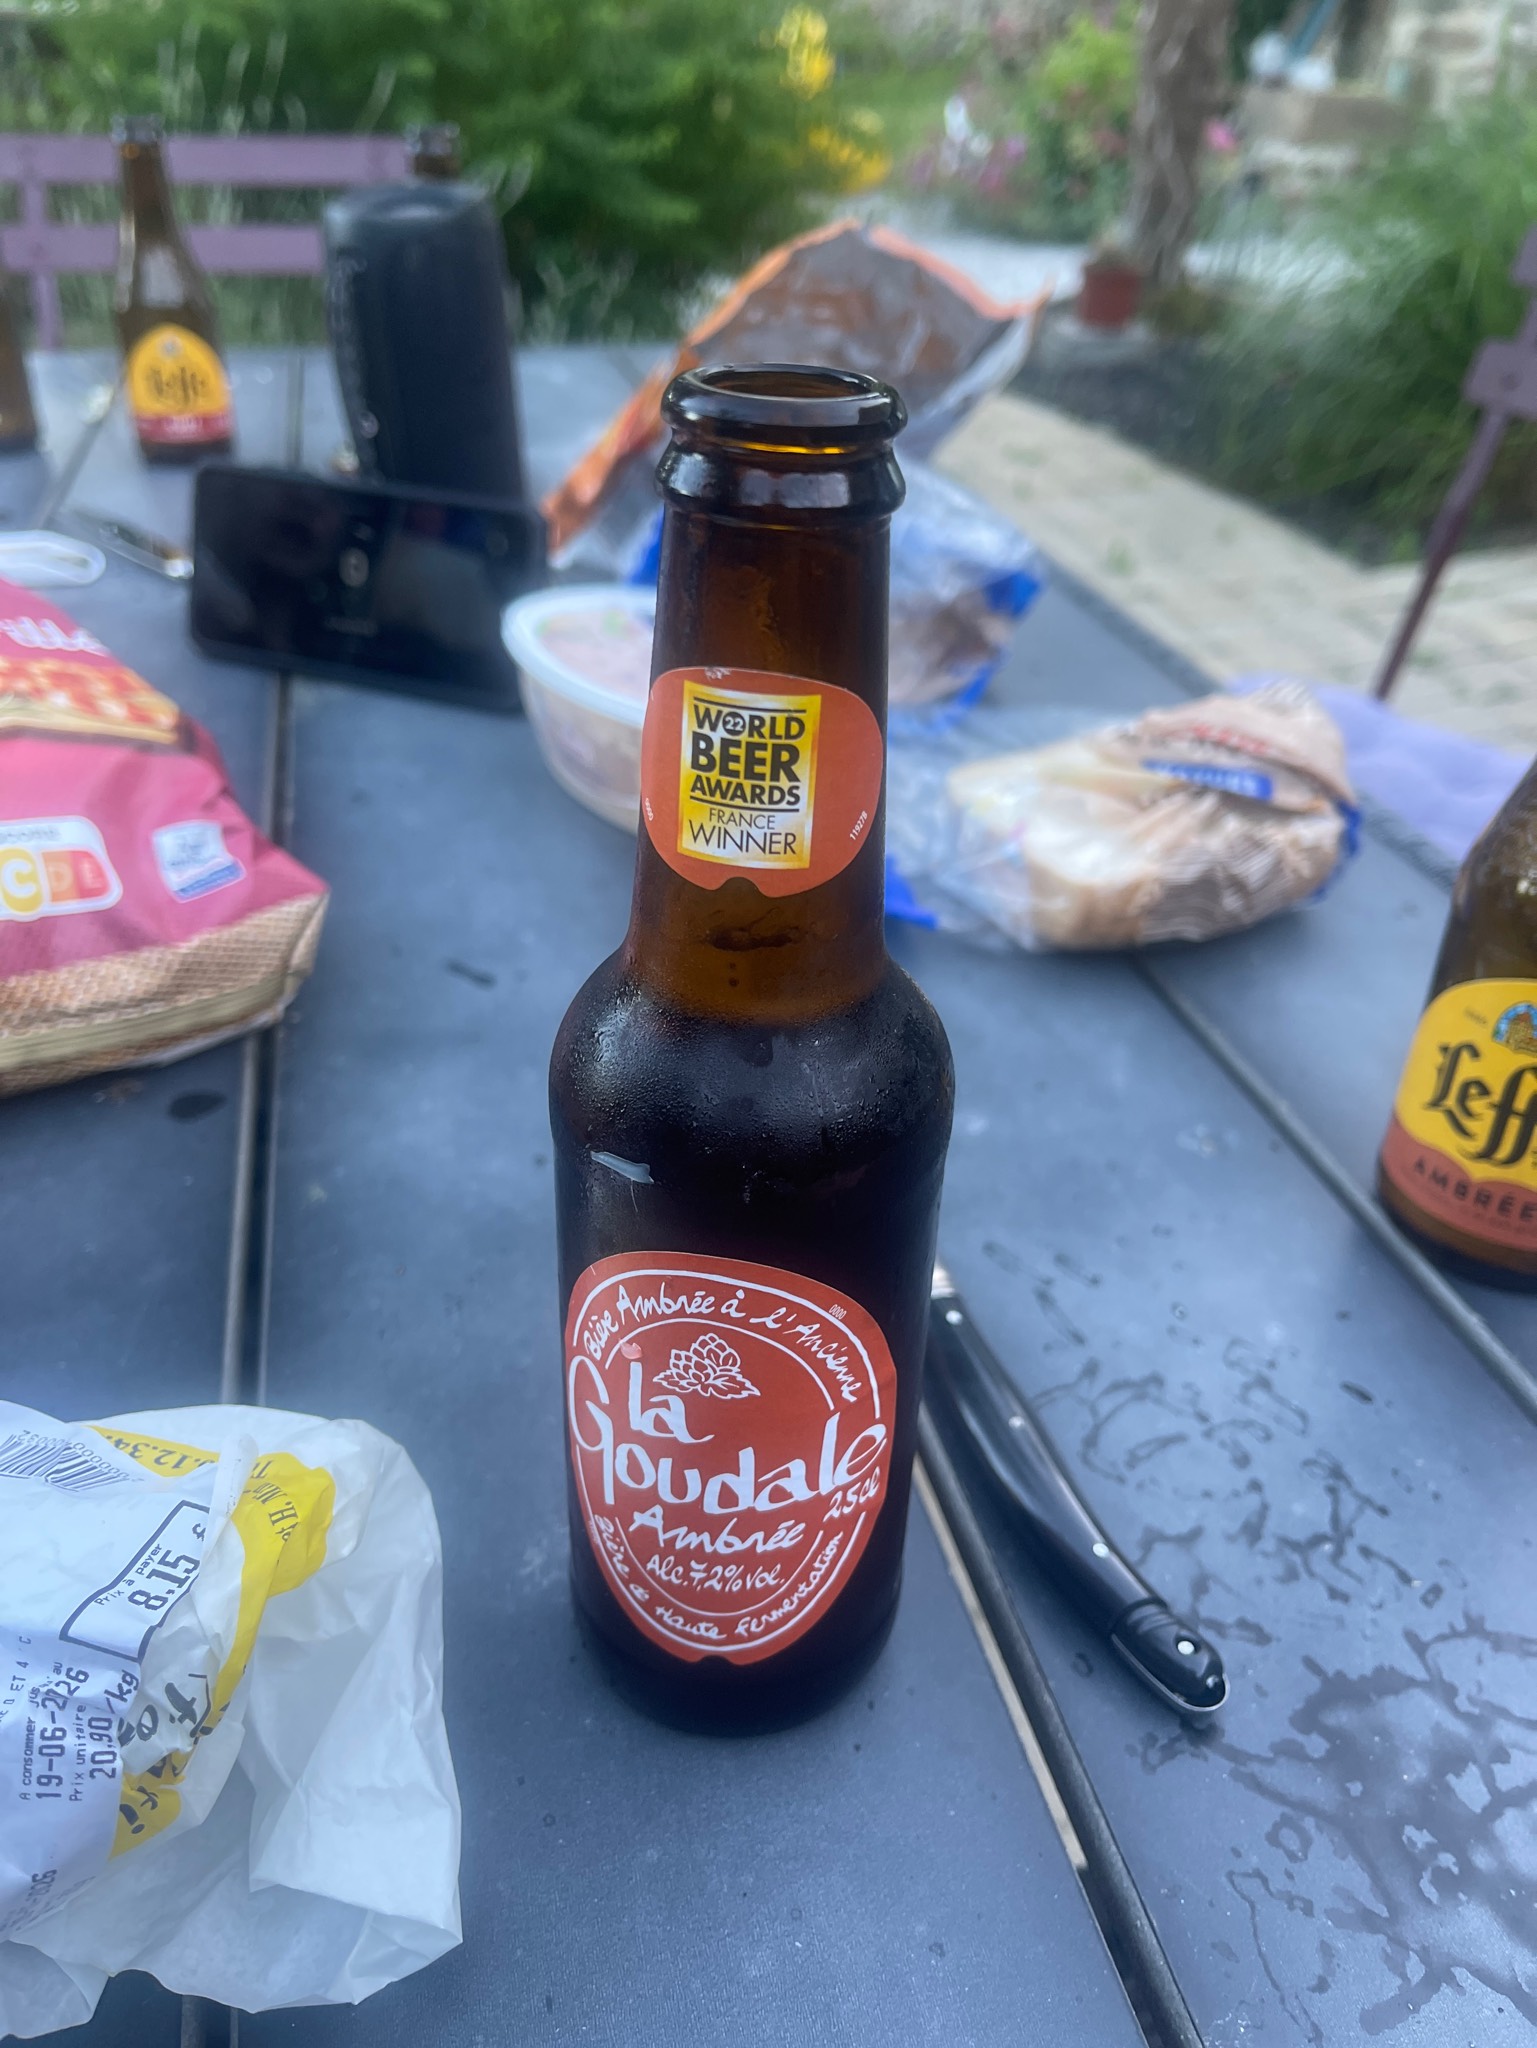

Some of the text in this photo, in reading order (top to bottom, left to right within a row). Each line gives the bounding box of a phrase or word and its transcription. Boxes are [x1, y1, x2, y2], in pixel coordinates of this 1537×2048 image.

[693, 704, 806, 741] WORLD
[690, 732, 801, 783] BEER
[690, 774, 801, 806] AWARDS
[689, 820, 797, 855] WINNER
[708, 808, 776, 831] FRANCE
[616, 1281, 716, 1326] Ambrée
[720, 1289, 747, 1318] à
[568, 1355, 887, 1515] Goudale
[628, 1504, 806, 1555] Ambrée
[93, 1542, 163, 1607] Prix à payer
[127, 1548, 201, 1612] 8,15
[10, 1674, 27, 1692] ET
[15, 1660, 29, 1670] 4
[22, 1716, 36, 1787] consommer
[68, 1703, 87, 1802] Prix unitaire
[19, 1791, 31, 1801] A
